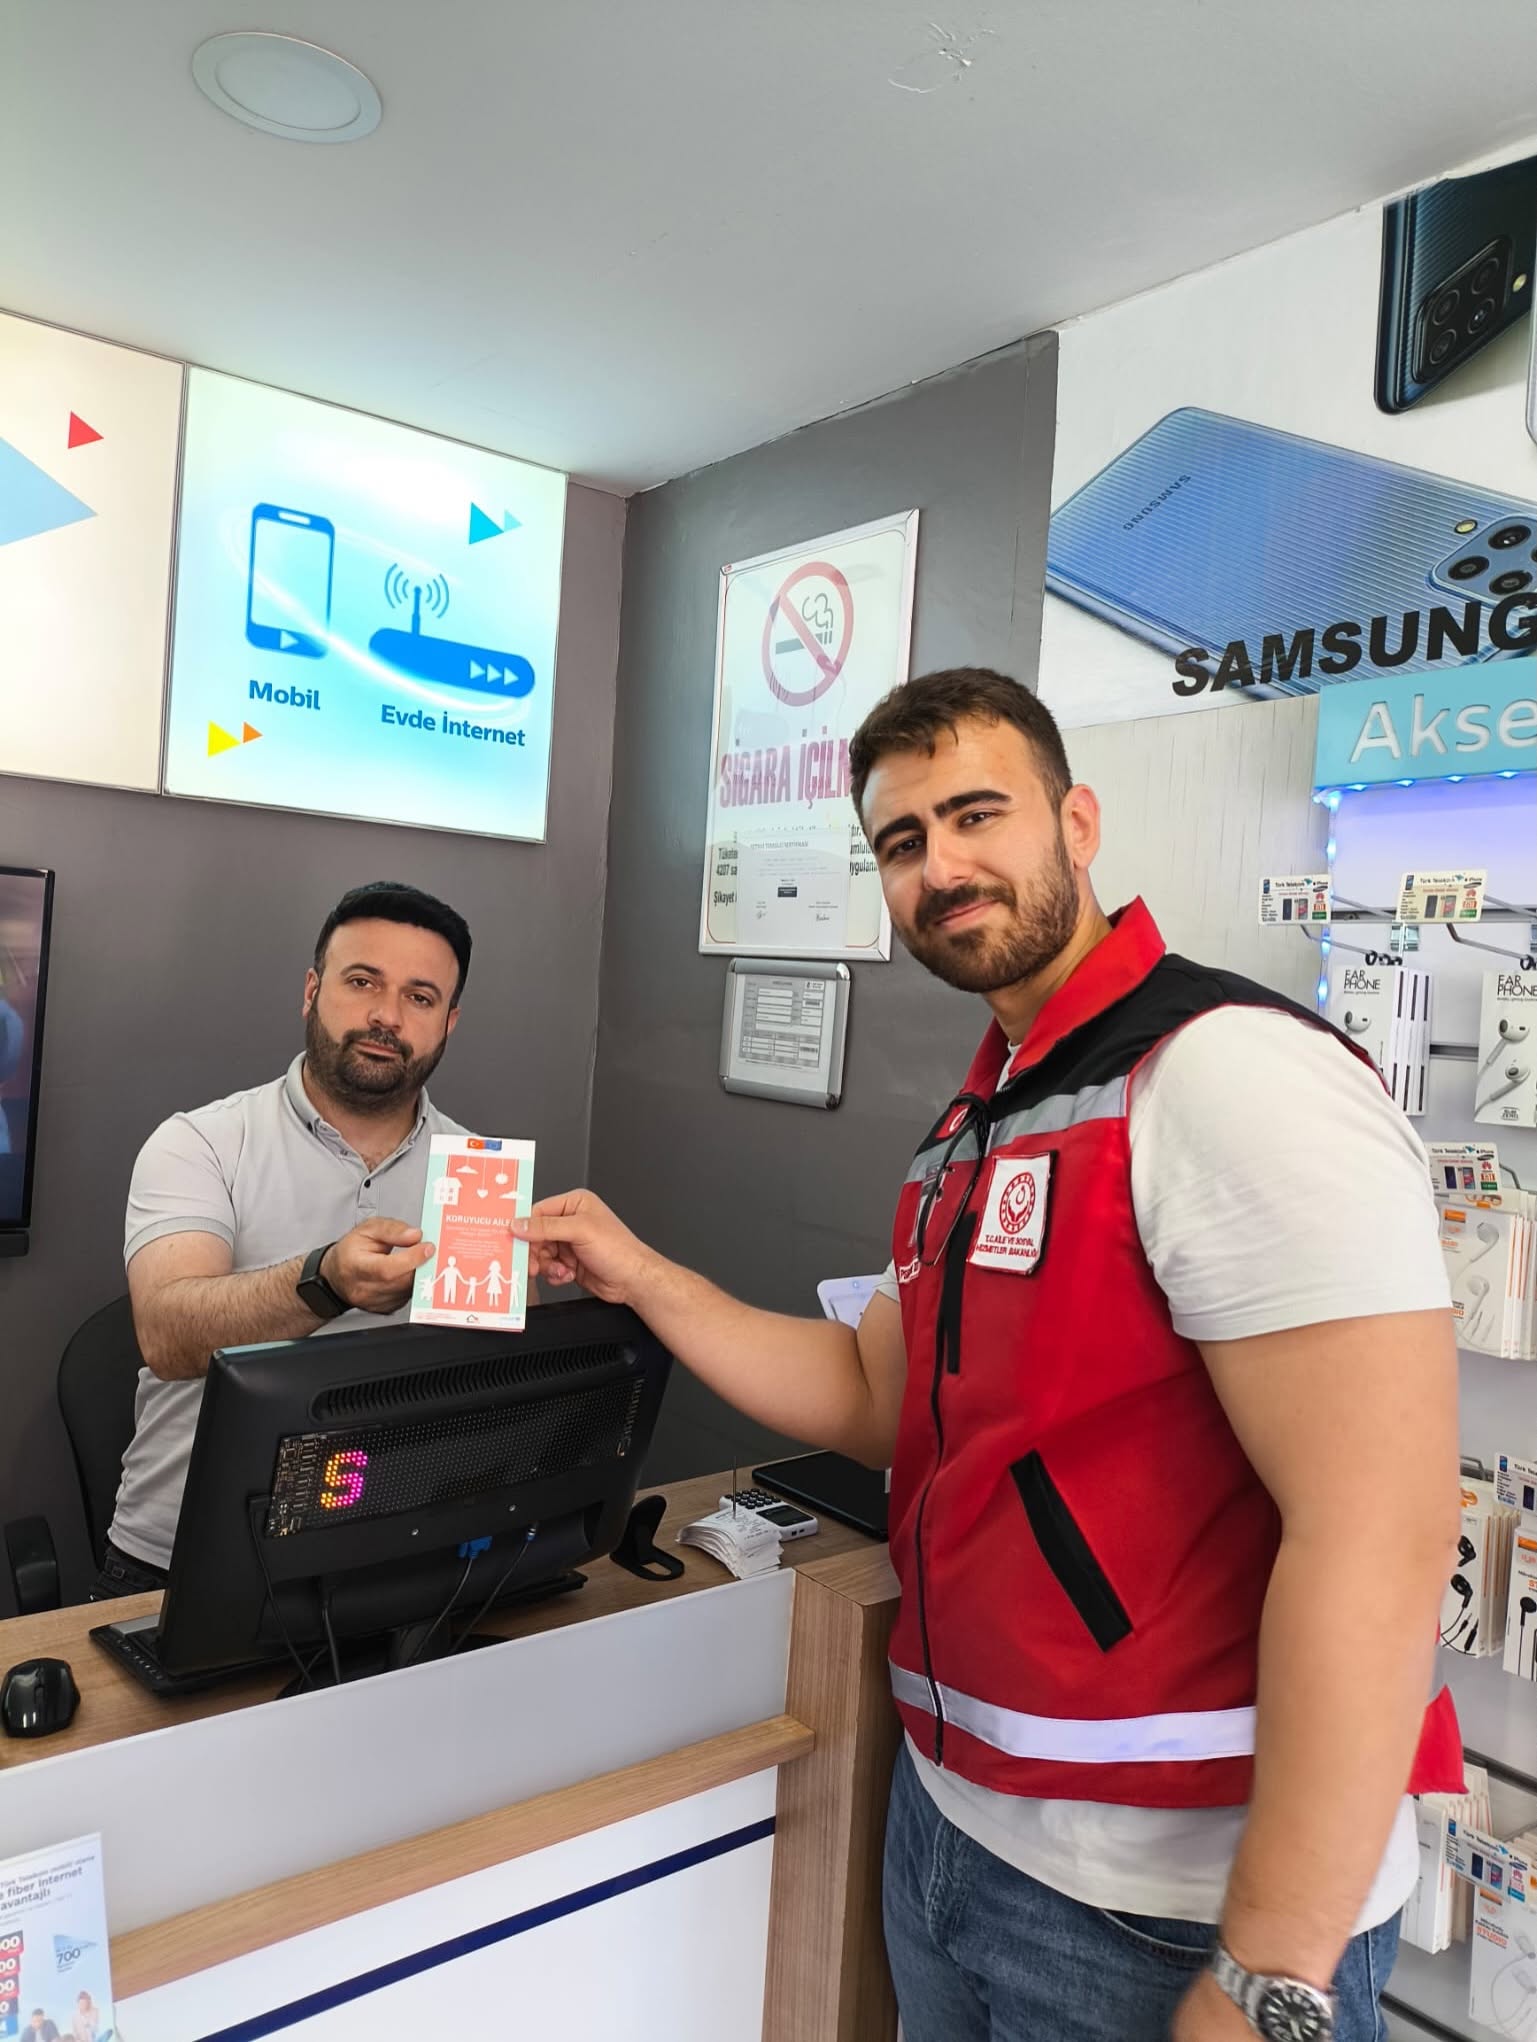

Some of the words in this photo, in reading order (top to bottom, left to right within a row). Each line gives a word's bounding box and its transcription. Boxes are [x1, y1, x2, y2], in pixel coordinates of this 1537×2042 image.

[1122, 474, 1191, 531] SAMSUNG
[1172, 591, 1537, 697] SAMSUNG
[248, 679, 321, 712] Mobil
[381, 704, 436, 732] Evde
[441, 711, 526, 747] İnternet
[1349, 694, 1537, 764] Akse
[720, 738, 791, 808] SİGARA
[713, 890, 734, 907] Şikayet
[1345, 969, 1366, 980] EAR
[1498, 974, 1522, 986] EAR
[1344, 979, 1381, 990] PHONE
[1497, 984, 1537, 997] PHONE
[446, 1214, 491, 1226] KORUYUCU
[7, 1882, 35, 1898] fiber
[56, 1947, 81, 1965] 700
